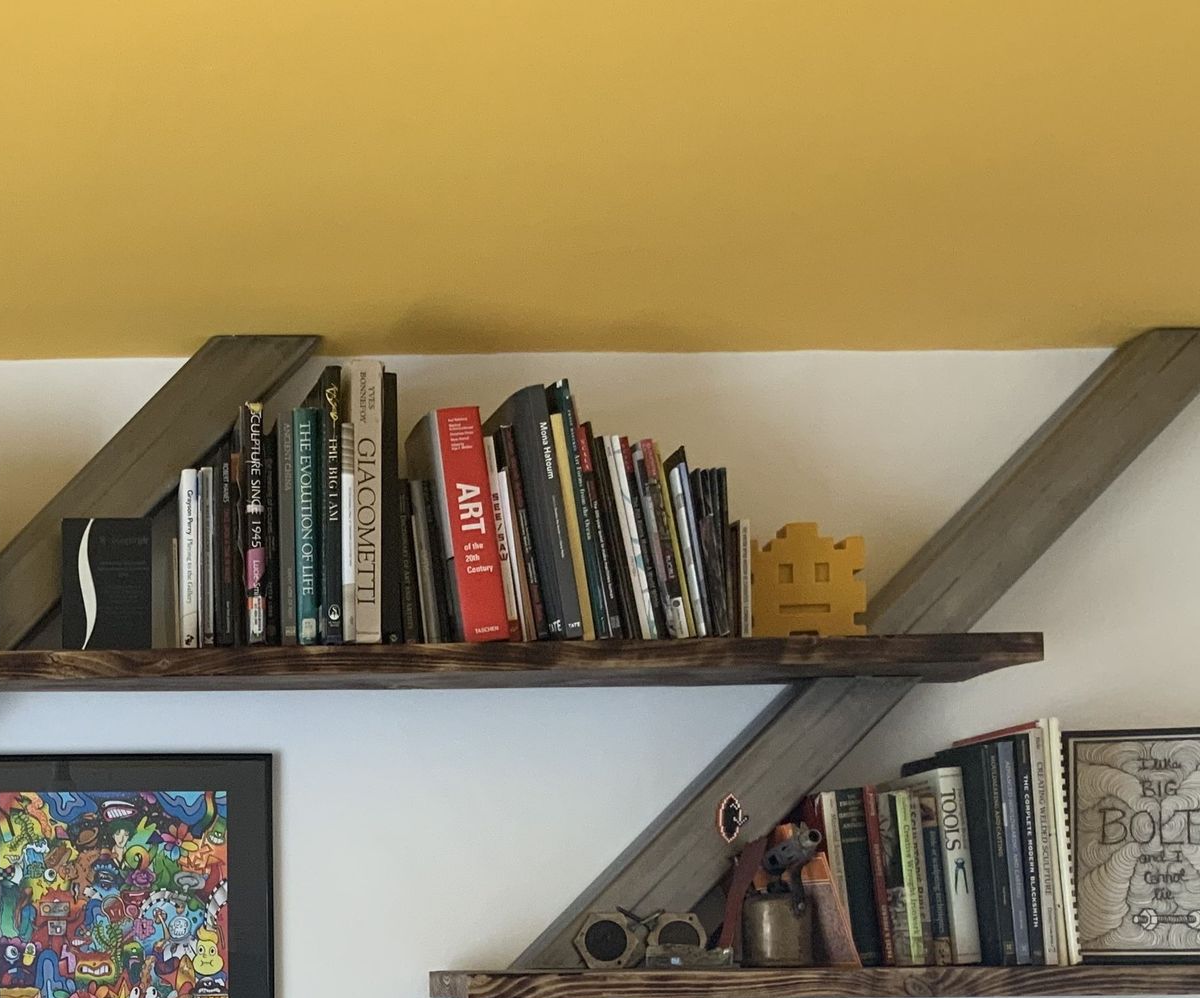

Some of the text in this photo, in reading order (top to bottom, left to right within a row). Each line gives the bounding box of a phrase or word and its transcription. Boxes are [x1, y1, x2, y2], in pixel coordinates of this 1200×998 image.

[357, 371, 368, 423] BONNEFOY
[367, 386, 375, 409] YVES
[327, 437, 338, 462] THE
[539, 421, 555, 479] Mona Hatoum
[327, 467, 338, 488] BIG
[250, 479, 261, 514] SINCE
[298, 421, 314, 595] THE EVOLUTION OF LIFE
[328, 500, 338, 520] AM
[456, 482, 486, 535] ART
[185, 517, 193, 535] Perry
[251, 520, 261, 547] 1945
[354, 438, 378, 605] GIACOMETTI
[464, 543, 483, 551] of the
[465, 554, 480, 562] 20th
[467, 565, 493, 574] Century
[185, 581, 193, 603] Gallery
[475, 625, 499, 634] TASCHEN
[1035, 762, 1046, 805] CREATING
[1141, 780, 1178, 797] BIG
[940, 788, 962, 852] TOOLS
[1022, 793, 1033, 835] COMPLETE
[1038, 806, 1049, 844] WELDED
[1026, 839, 1035, 872] MODERN
[1041, 845, 1052, 895] SCULPTURE
[1139, 851, 1164, 863] and
[902, 824, 912, 857] Creative
[909, 898, 920, 935] Ironwork
[1028, 875, 1040, 927] BLACKSMITH
